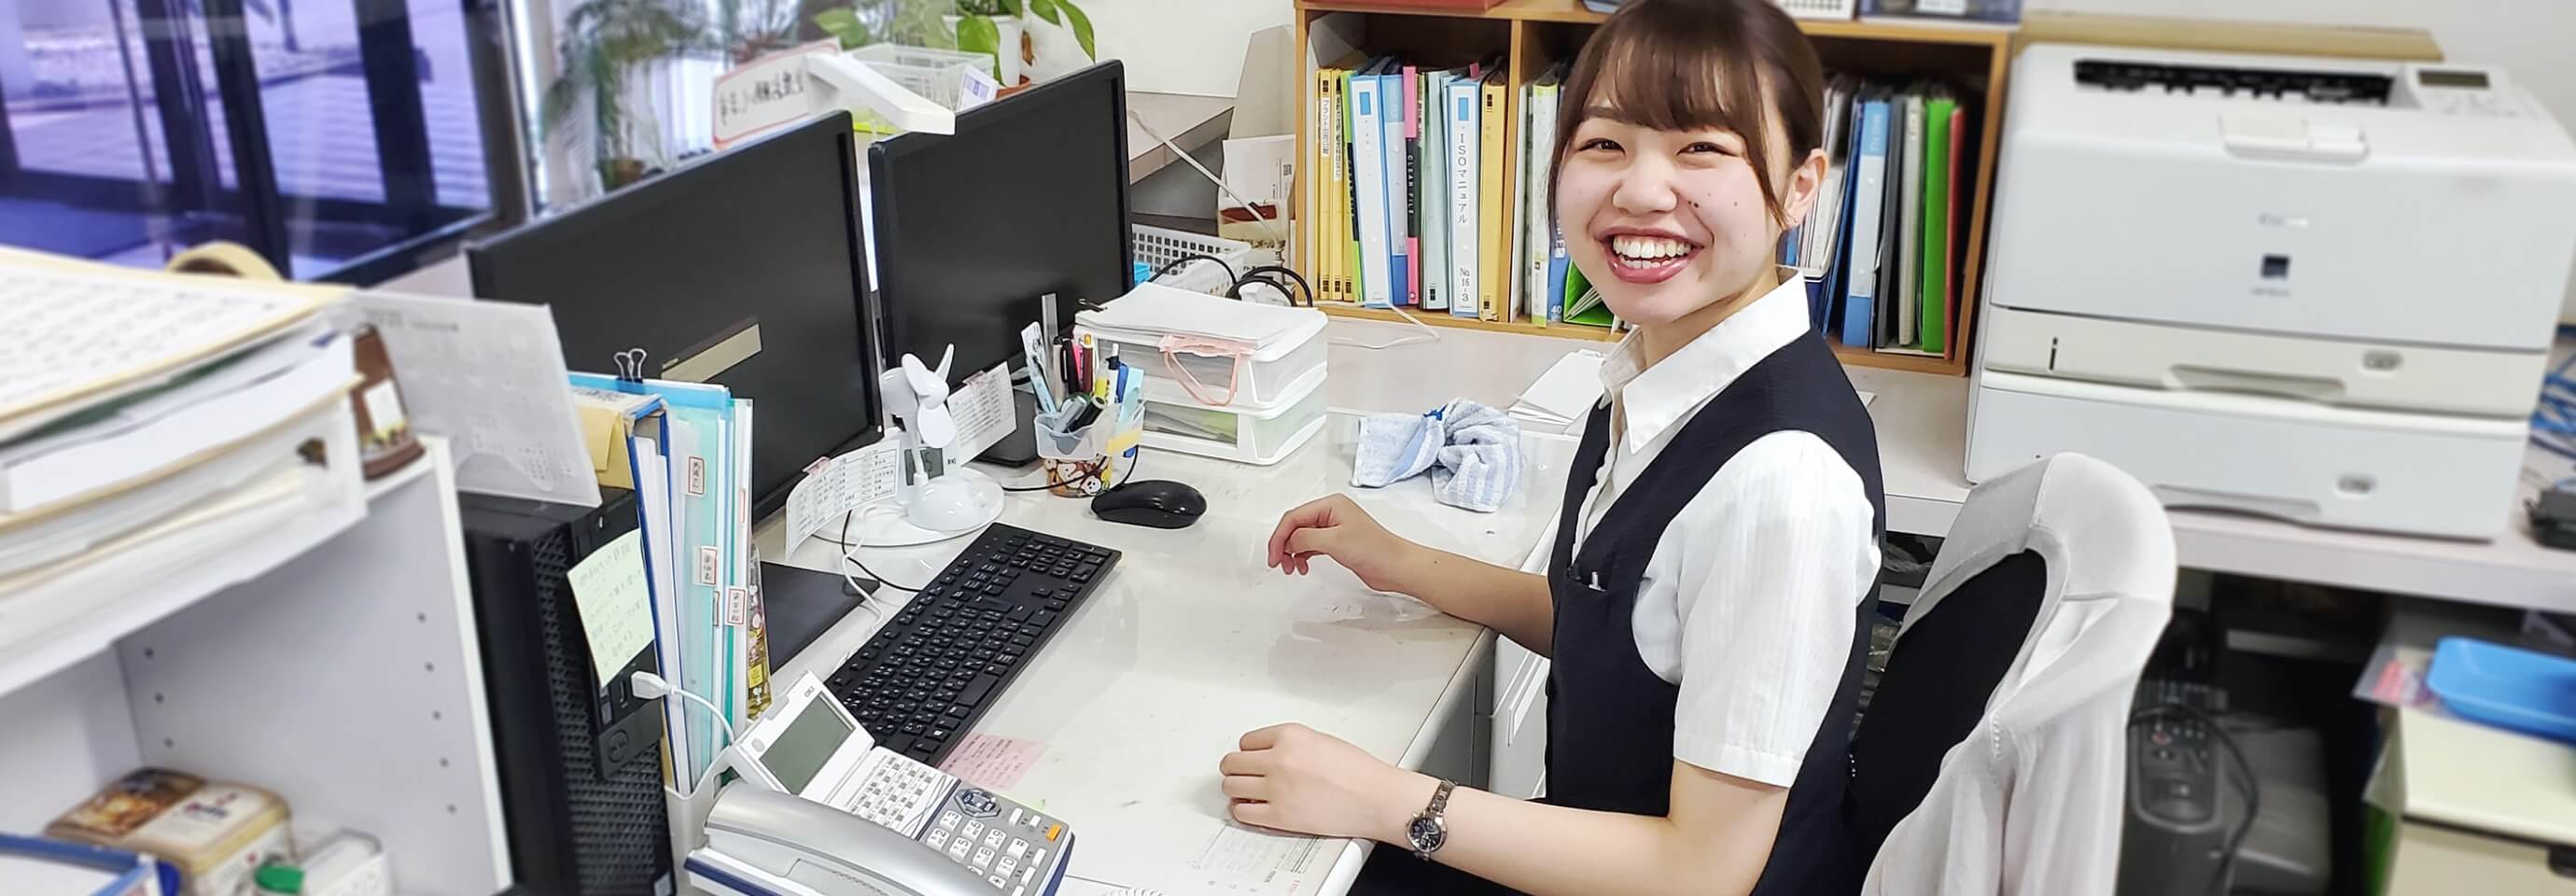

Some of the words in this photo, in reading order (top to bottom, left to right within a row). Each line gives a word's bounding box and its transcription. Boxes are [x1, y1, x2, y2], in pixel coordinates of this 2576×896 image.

[1457, 133, 1468, 224] ISOマニュアル
